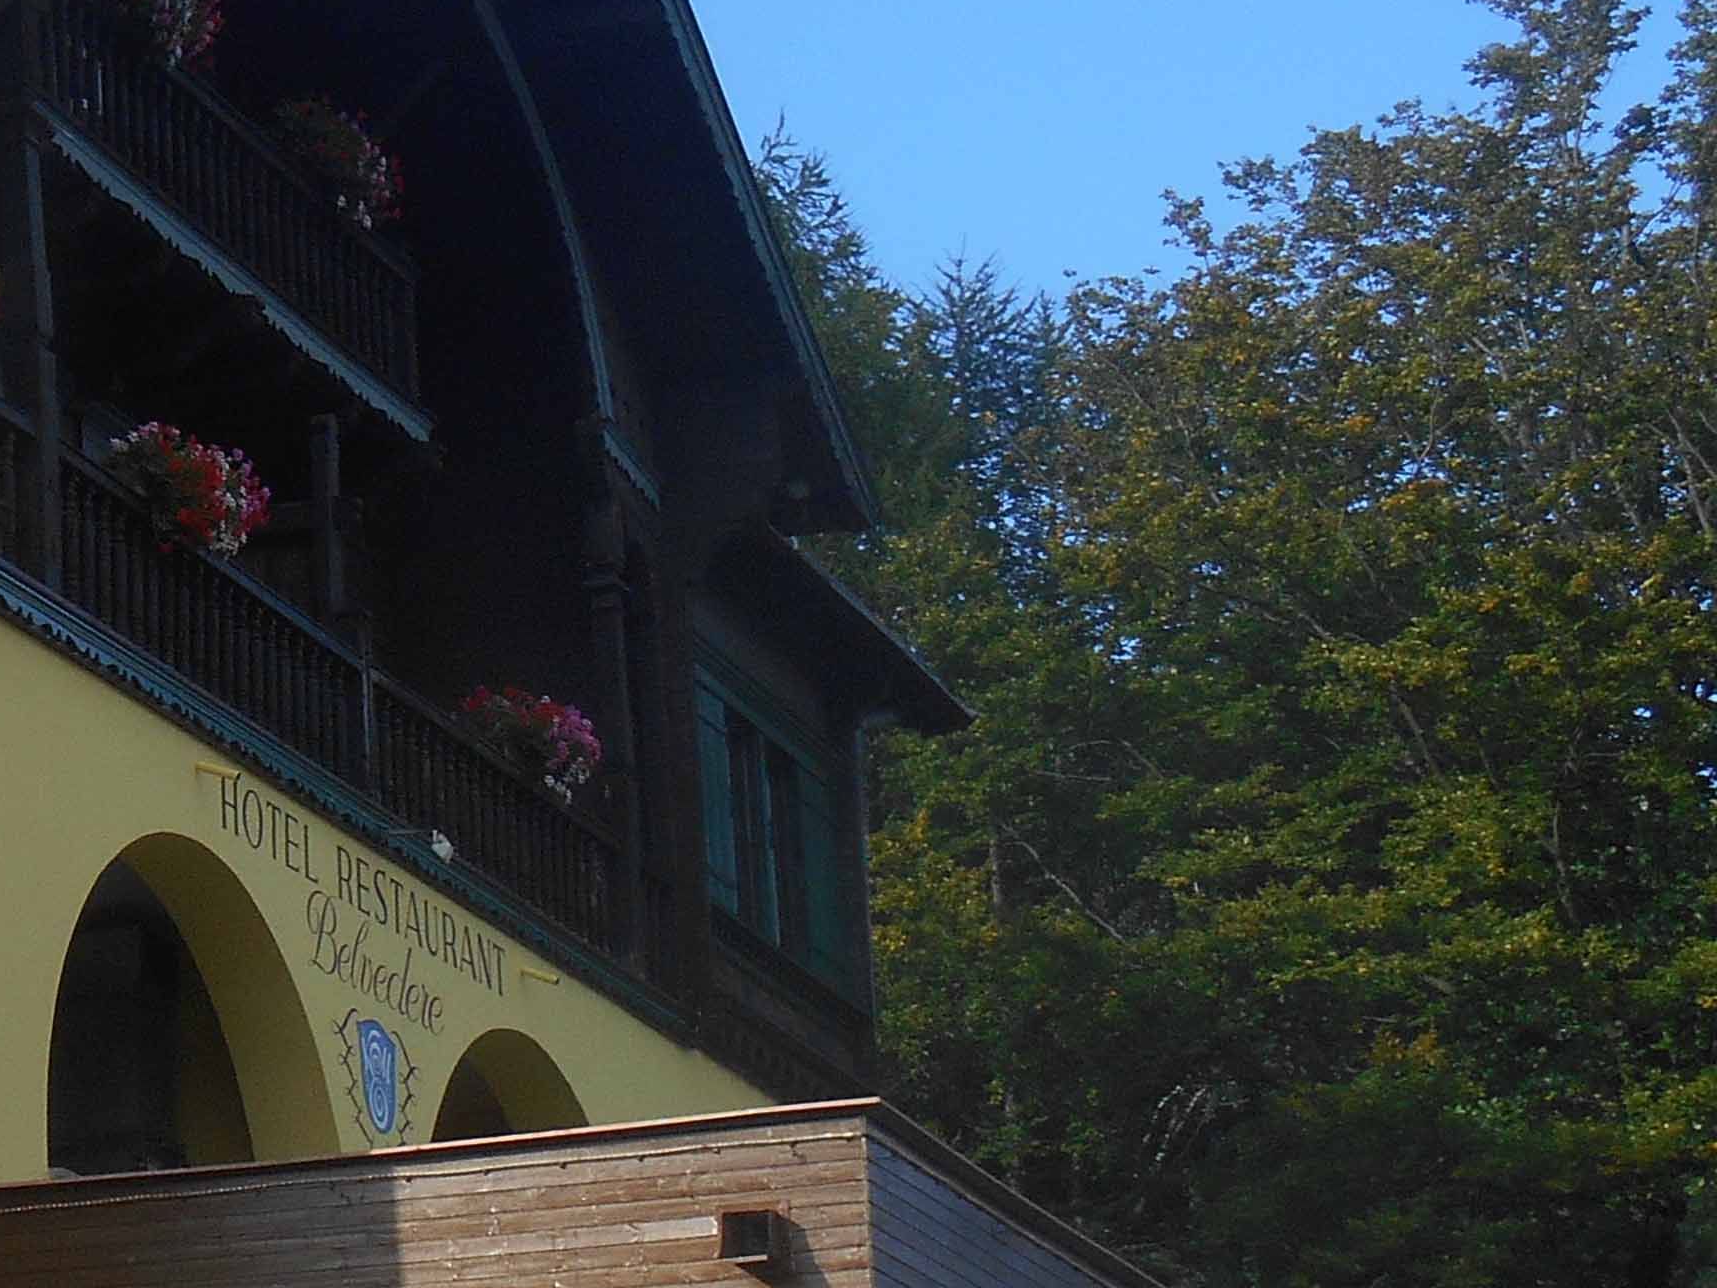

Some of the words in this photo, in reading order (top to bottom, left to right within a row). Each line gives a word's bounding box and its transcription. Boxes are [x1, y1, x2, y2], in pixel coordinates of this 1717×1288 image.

[220, 773, 319, 884] HOTEL
[336, 844, 507, 997] RESTAURANT
[306, 889, 446, 1036] Belvedere
